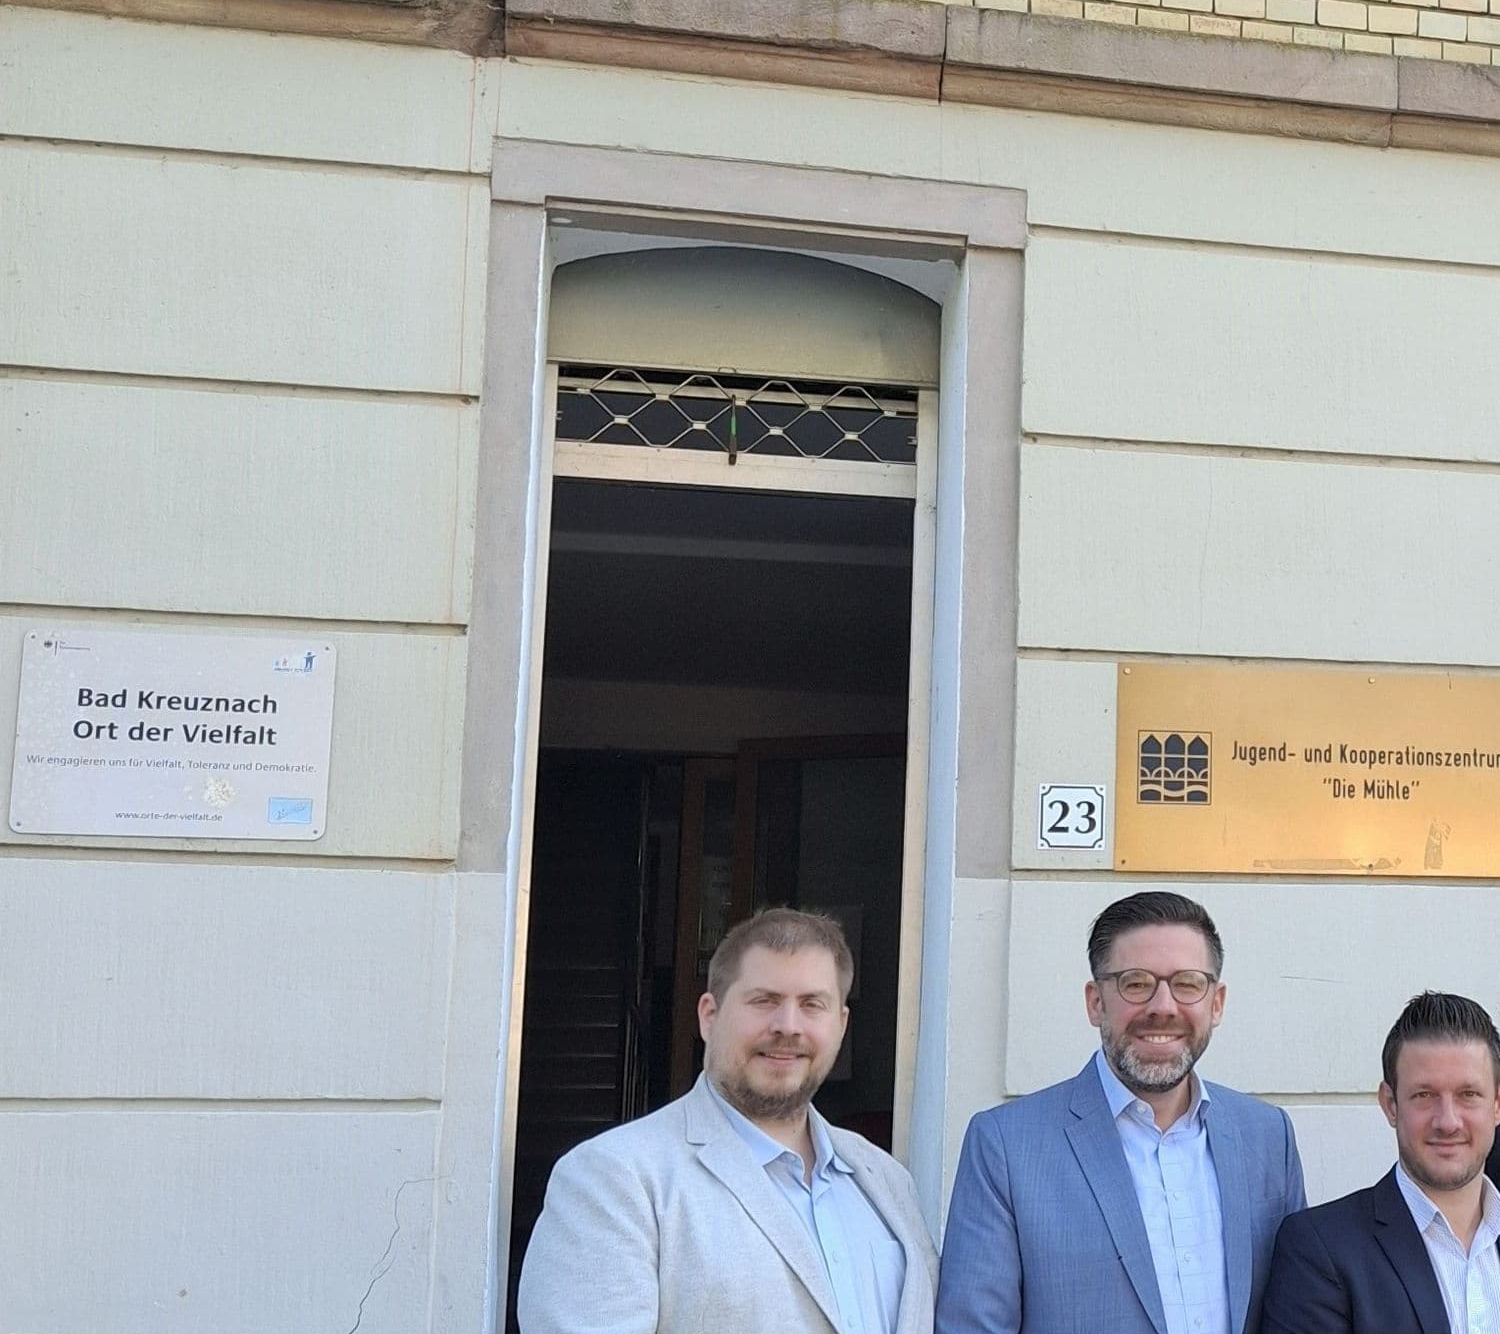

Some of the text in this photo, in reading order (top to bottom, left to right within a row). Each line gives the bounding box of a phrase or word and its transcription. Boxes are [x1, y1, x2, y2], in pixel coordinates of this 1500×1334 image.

[77, 688, 277, 714] Bad Kreuznach
[73, 720, 277, 745] Ort der Vielfalt
[26, 754, 44, 764] Wir
[47, 755, 106, 767] engagieren
[1232, 740, 1296, 766] Jugend-
[1304, 744, 1332, 764] und
[1047, 799, 1097, 834] 23
